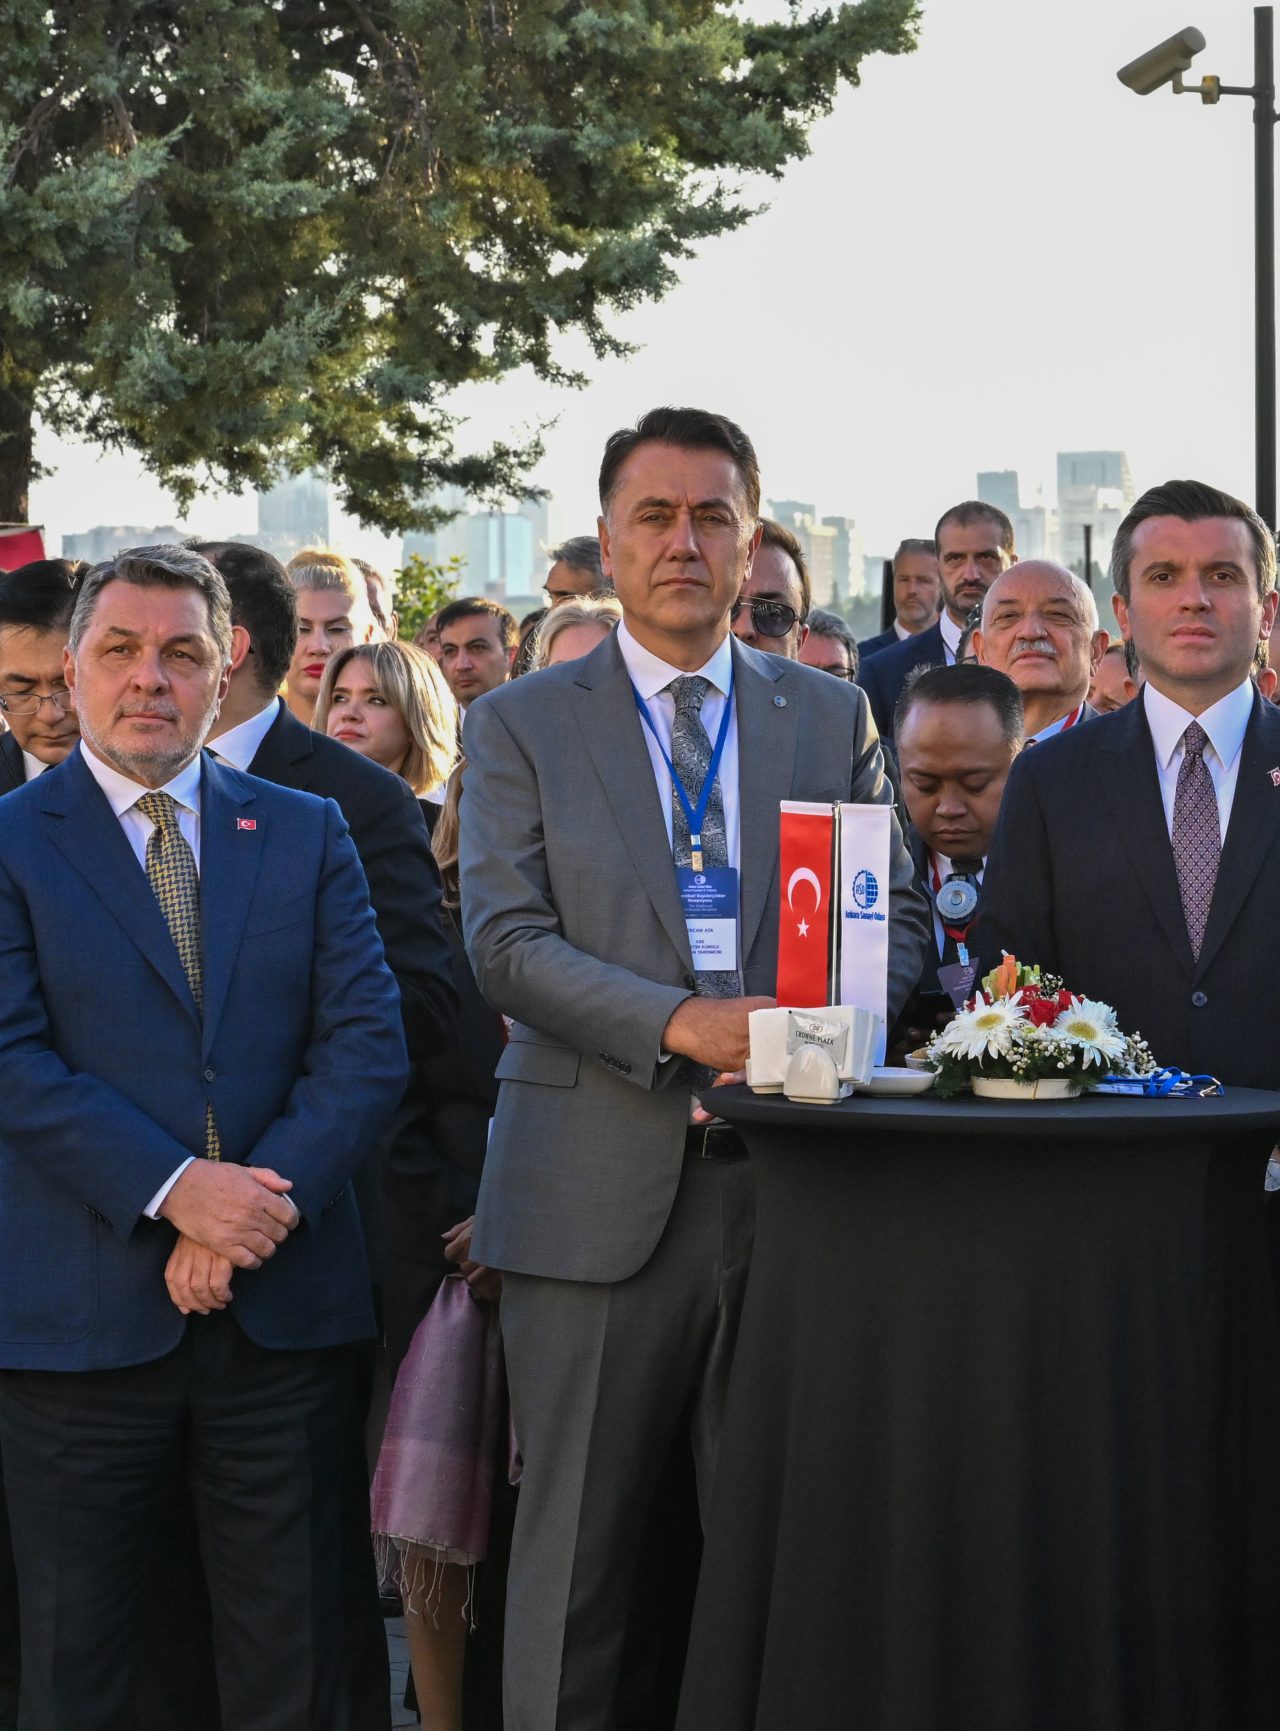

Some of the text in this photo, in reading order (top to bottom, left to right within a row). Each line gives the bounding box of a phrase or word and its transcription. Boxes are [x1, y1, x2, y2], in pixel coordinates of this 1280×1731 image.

[845, 910, 886, 922] Ankara Sanayi Odası
[795, 1030, 817, 1041] CROWNE
[817, 1035, 834, 1046] PLAZA
